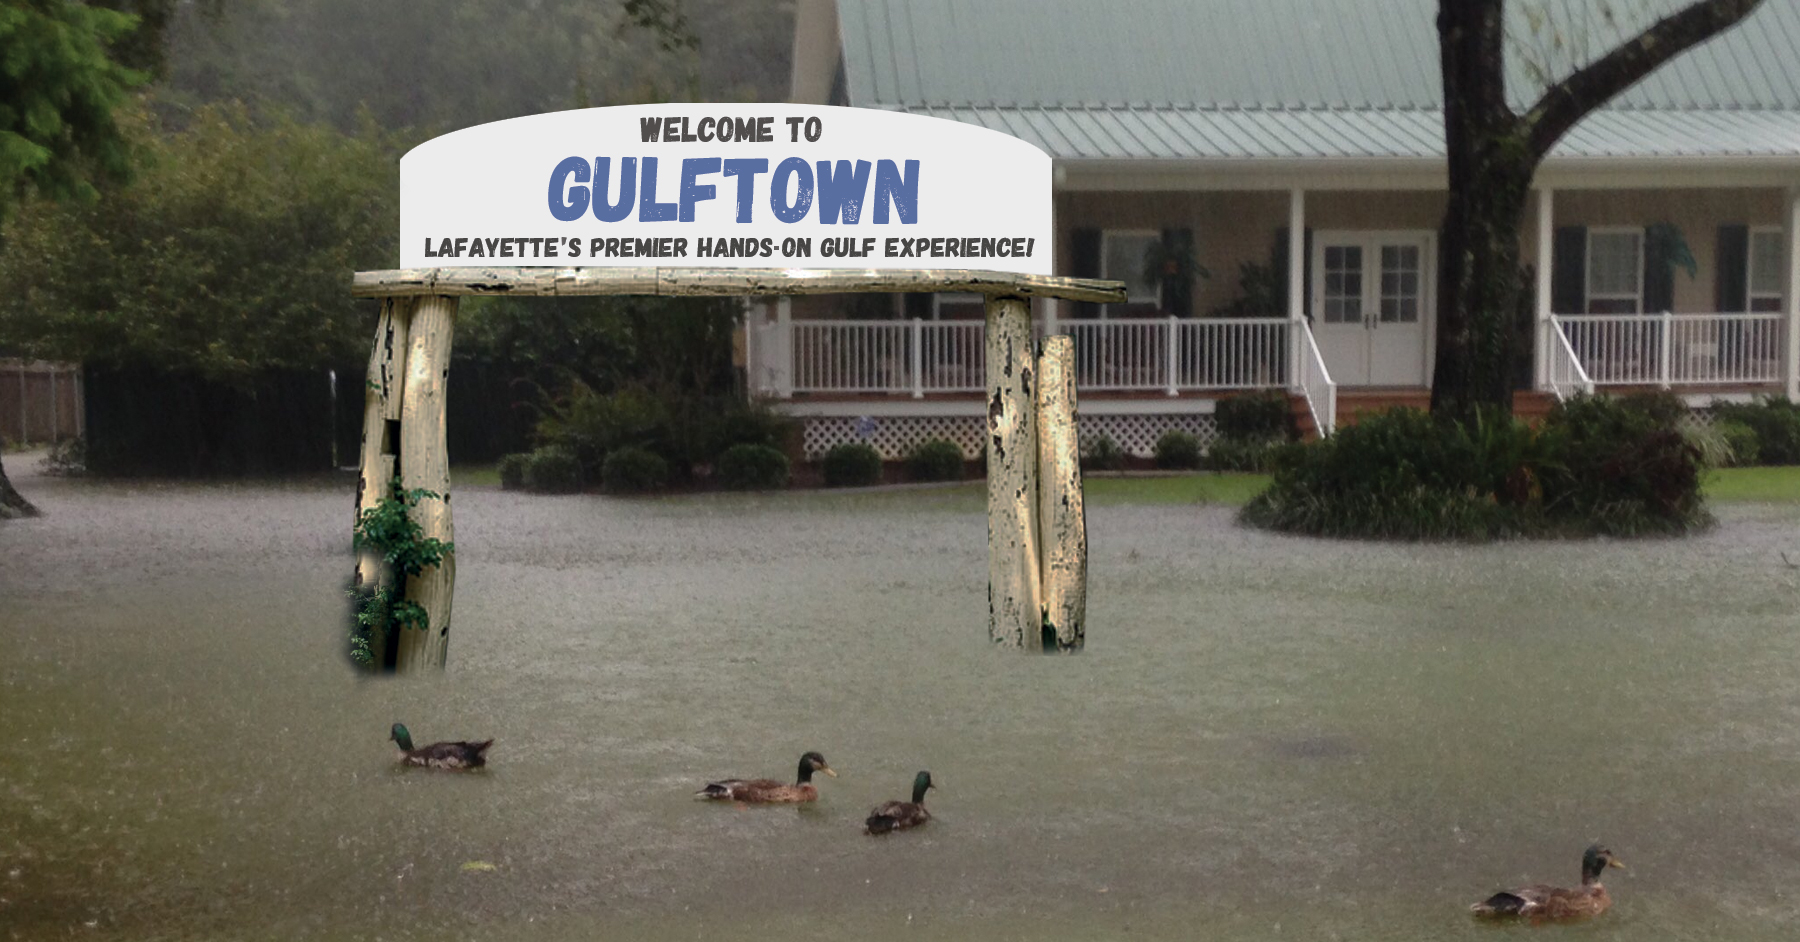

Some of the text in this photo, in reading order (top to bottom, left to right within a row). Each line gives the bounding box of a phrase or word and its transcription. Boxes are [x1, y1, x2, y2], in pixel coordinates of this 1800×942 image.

[639, 116, 822, 143] WELCOME TO
[547, 155, 920, 224] GULFTOWN
[424, 236, 1035, 258] LAFAYETTE'S PREMIER HANDS-ON GULF EXPERIENCE!
